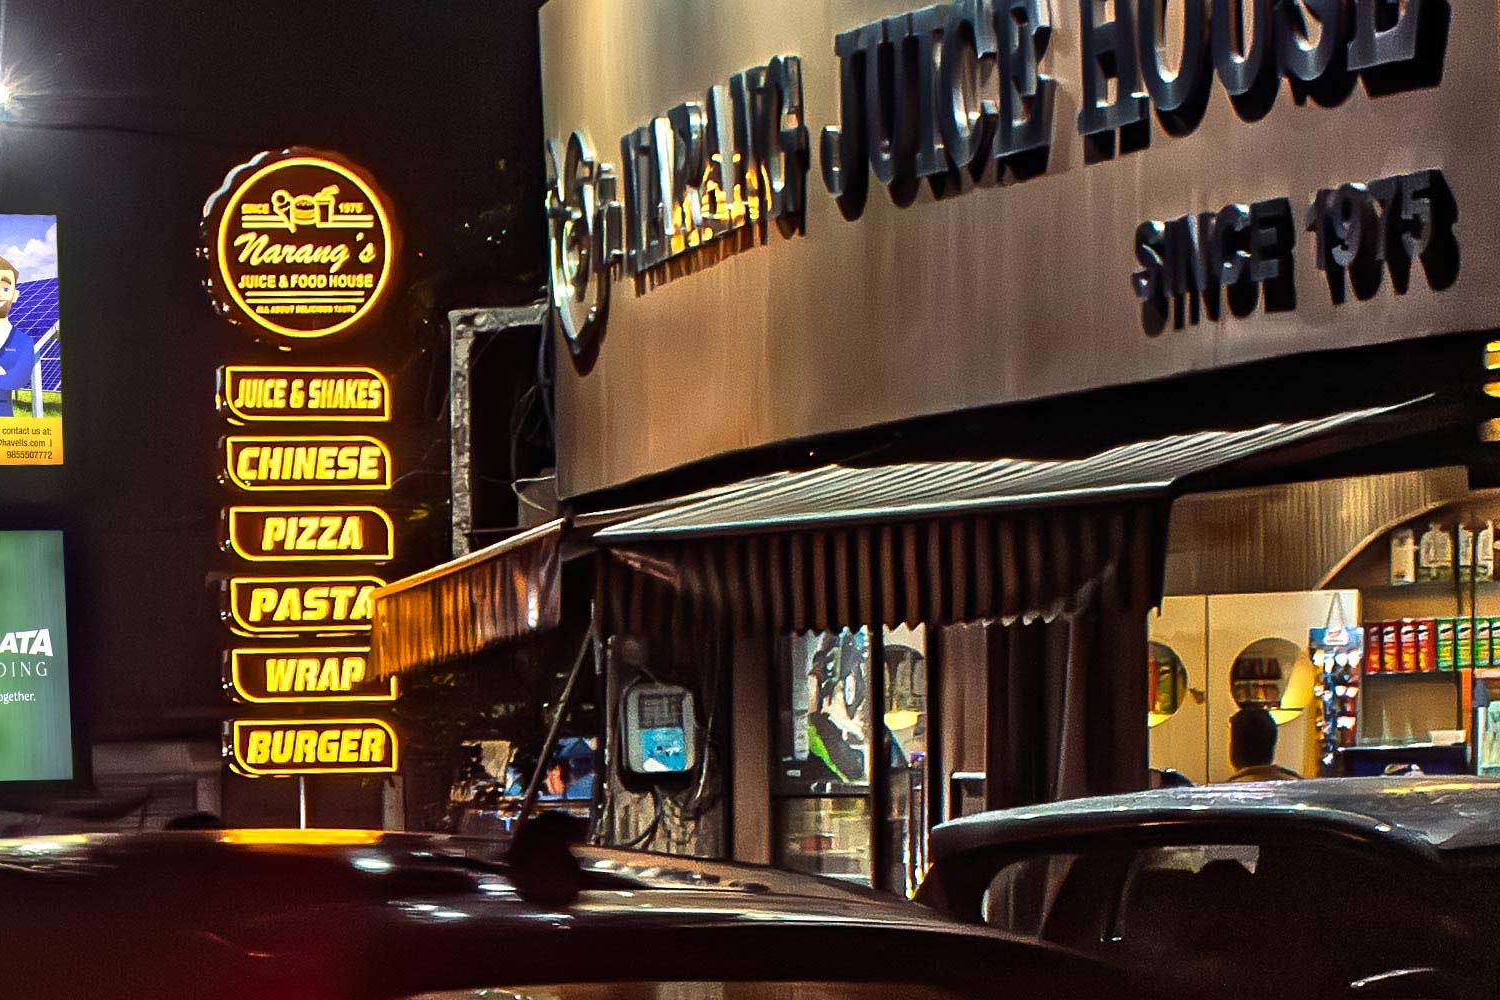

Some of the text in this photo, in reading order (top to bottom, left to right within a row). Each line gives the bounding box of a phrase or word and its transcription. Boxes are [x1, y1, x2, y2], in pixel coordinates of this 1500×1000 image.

[820, 0, 1057, 198] JUICE
[1132, 169, 1436, 300] SINCE 1975
[234, 232, 376, 273] Narang's
[238, 274, 373, 288] JUICE & FOOD HOUSE
[235, 379, 382, 409] JUICE & SHAKES
[2, 427, 29, 435] contact
[237, 446, 381, 480] CHINESE
[262, 516, 363, 550] PIZZA
[249, 586, 376, 622] PASTA
[266, 657, 366, 692] WRAP
[247, 728, 386, 764] BURGER
